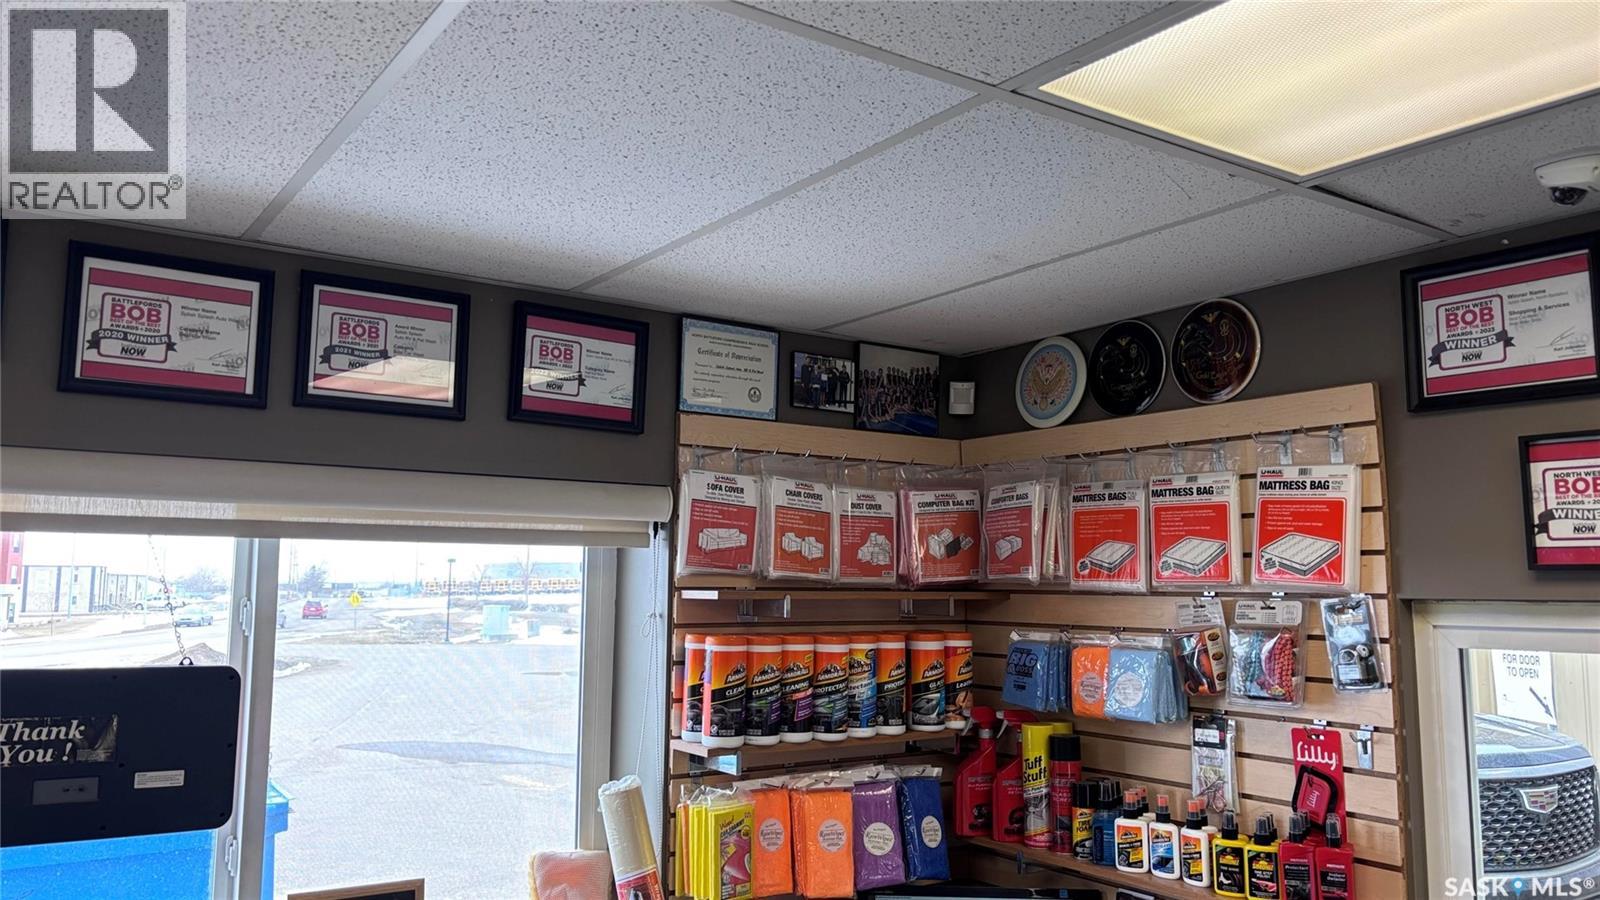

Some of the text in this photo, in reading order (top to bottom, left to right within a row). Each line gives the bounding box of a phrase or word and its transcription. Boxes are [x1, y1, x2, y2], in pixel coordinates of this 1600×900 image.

[1444, 300, 1493, 312] NORTH WEST
[110, 303, 162, 324] BOB
[1446, 306, 1494, 328] BOB
[98, 330, 124, 339] 2020
[127, 333, 169, 344] WINNER
[338, 322, 380, 340] BOB
[1447, 330, 1473, 339] AWARDS
[1444, 335, 1498, 350] WINNER
[120, 346, 147, 356] NOW
[354, 348, 381, 358] WINNER
[539, 344, 574, 361] BOB
[1462, 352, 1482, 362] NOW
[348, 360, 368, 370] NOW
[546, 382, 564, 391] NOW
[724, 486, 744, 495] COVER
[1151, 487, 1194, 498] MATTRESS
[1196, 485, 1214, 496] BAG
[1258, 480, 1307, 490] MATTRESS
[1310, 480, 1330, 490] BAG
[786, 488, 823, 501] CHAIR COVERS
[1072, 492, 1127, 503] MATTRESS BAGS
[850, 502, 882, 510] DUST COVER
[1572, 526, 1596, 534] NOW
[1009, 652, 1038, 667] BIG
[1502, 654, 1540, 666] FOR DOOR
[1506, 666, 1540, 679] TO OPEN
[0, 720, 86, 742] Thank
[0, 745, 54, 767] You
[1024, 755, 1042, 770] Tuff
[1296, 741, 1338, 771] Lilly
[1024, 766, 1047, 783] Stuff
[1307, 790, 1320, 808] Lilly
